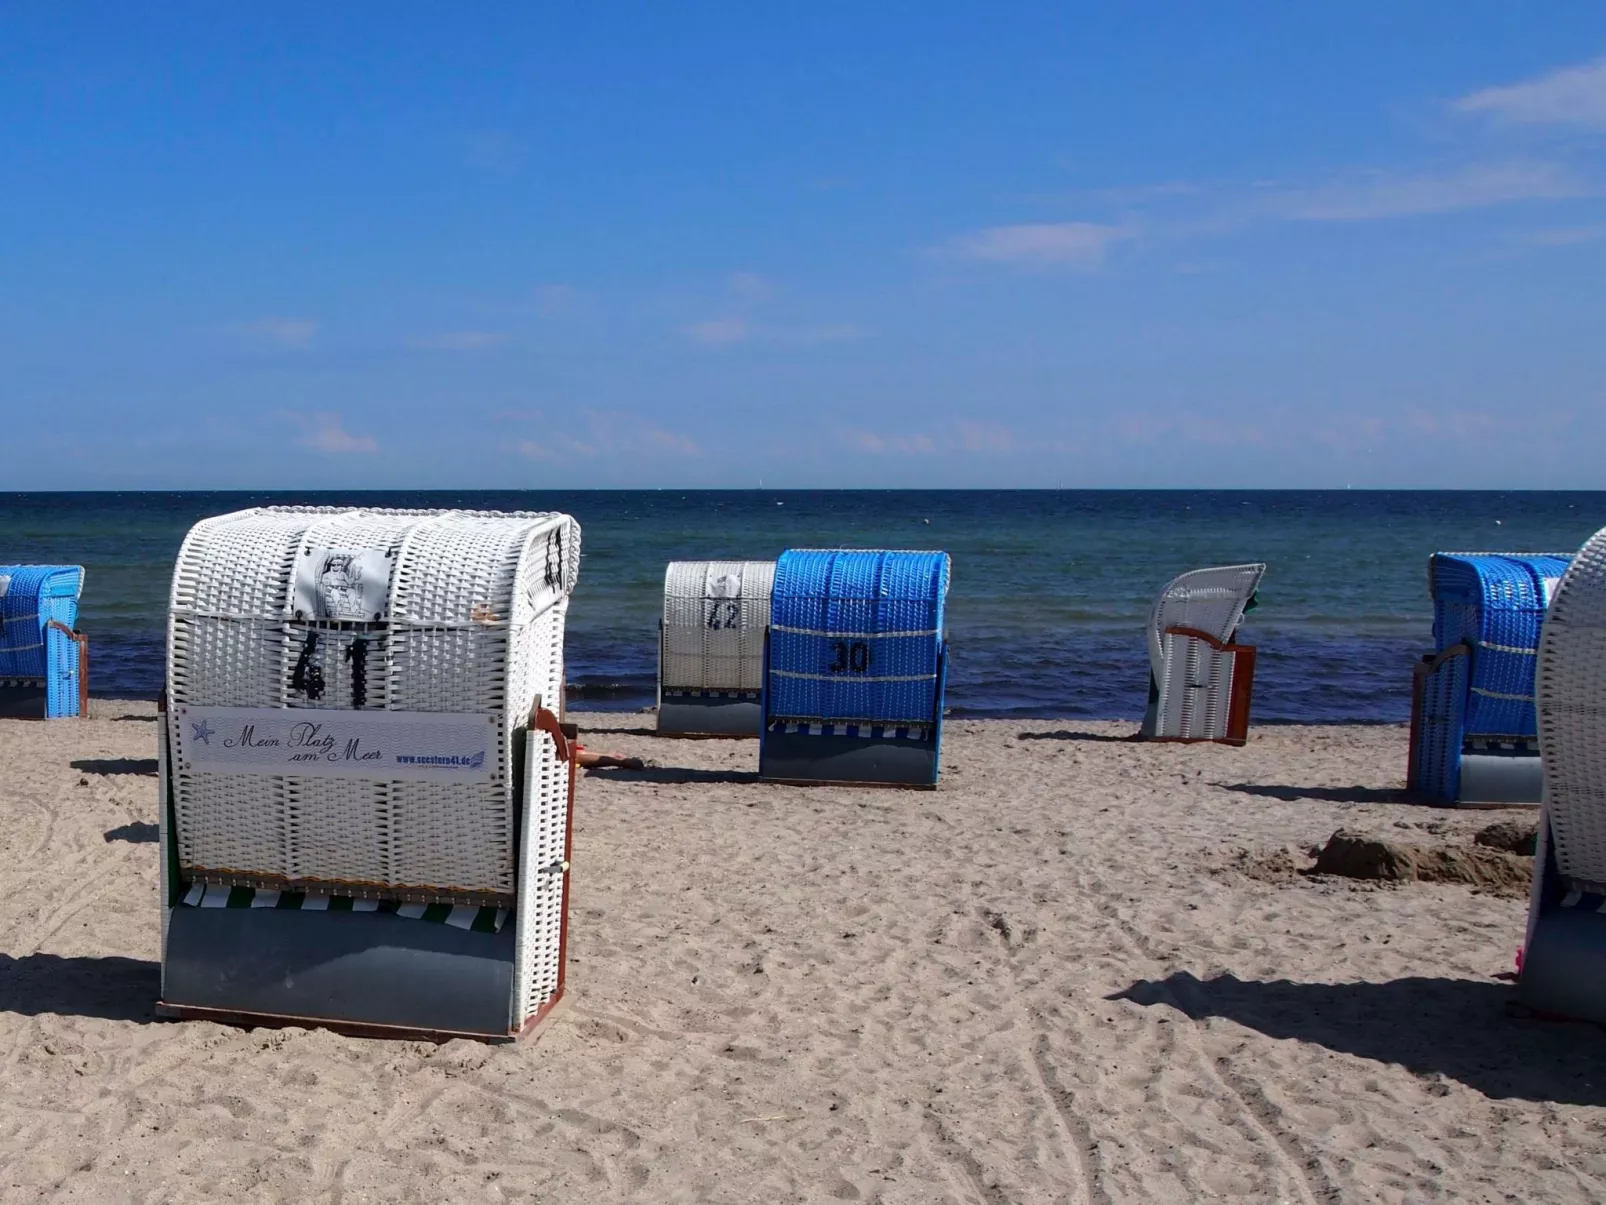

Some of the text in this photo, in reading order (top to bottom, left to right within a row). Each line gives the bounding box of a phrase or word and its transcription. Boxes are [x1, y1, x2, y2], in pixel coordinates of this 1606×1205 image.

[292, 631, 369, 709] 41
[223, 721, 335, 754] Mein Platz
[288, 738, 382, 762] am Meer
[396, 755, 471, 766] www.seestern41.de
